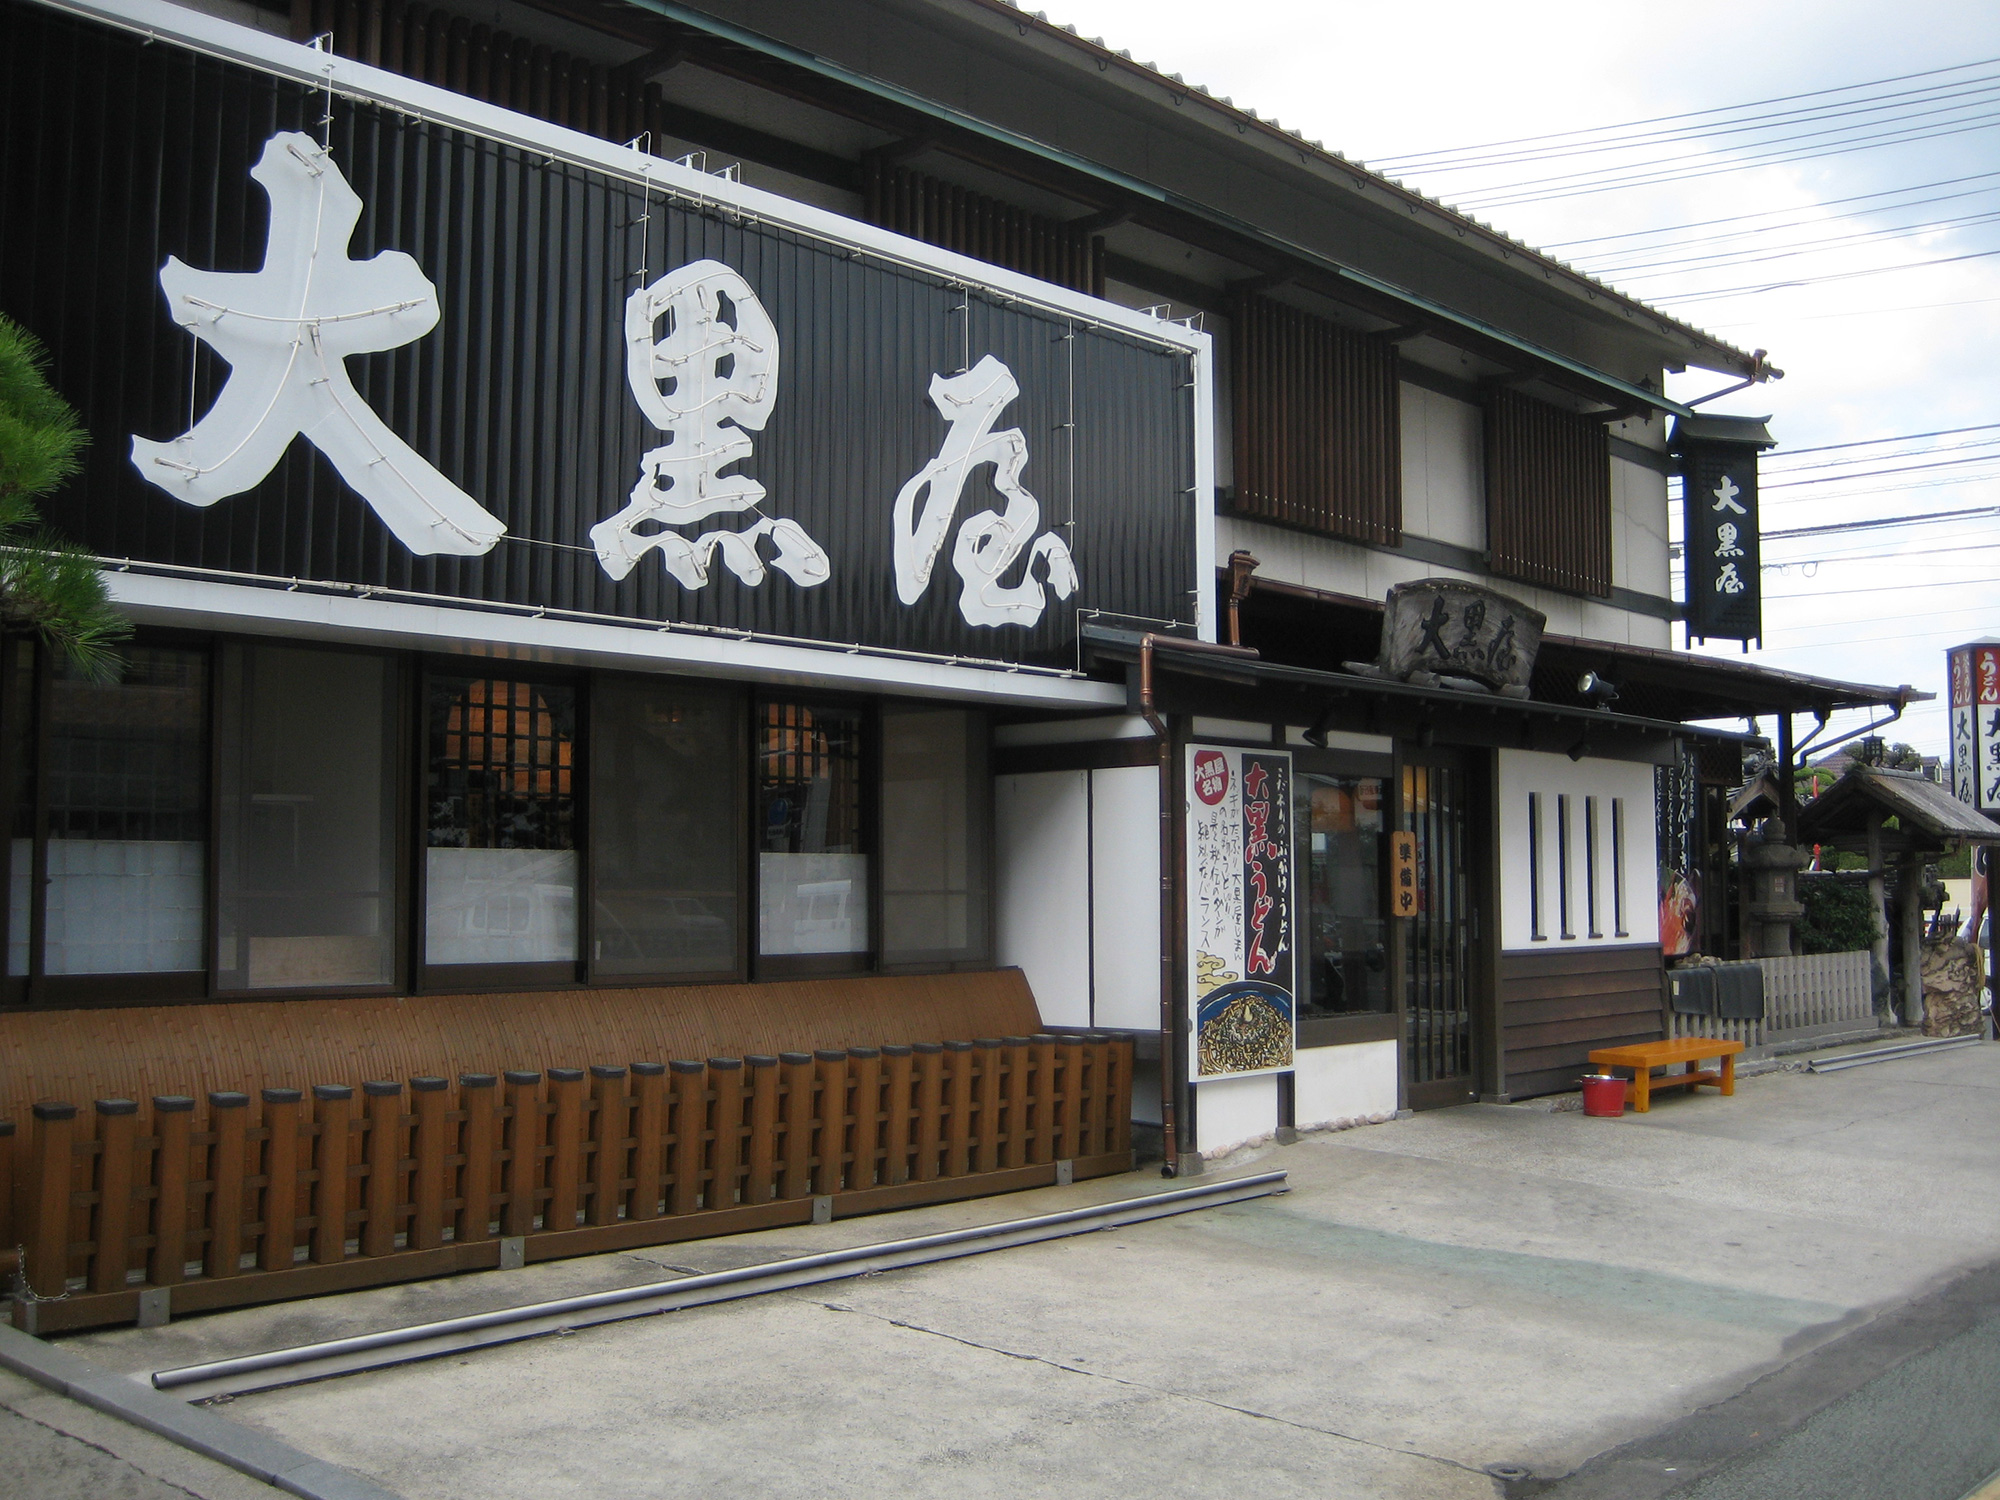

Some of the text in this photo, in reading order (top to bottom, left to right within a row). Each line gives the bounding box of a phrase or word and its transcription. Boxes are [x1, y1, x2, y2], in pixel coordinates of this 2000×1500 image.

[132, 130, 1077, 628] 大黒屋
[1711, 474, 1747, 594] 大黒屋
[1414, 594, 1517, 672] 大黒屋
[1953, 655, 1962, 705] うどん
[1979, 651, 1998, 702] うどん
[1195, 756, 1226, 783] 大黒屋
[1201, 775, 1223, 798] 名物
[1956, 710, 1972, 803] 大黒屋
[1197, 819, 1210, 948] 絶妙なバランス
[1244, 761, 1278, 974] 大黒うどん
[1399, 841, 1413, 912] 準備中
